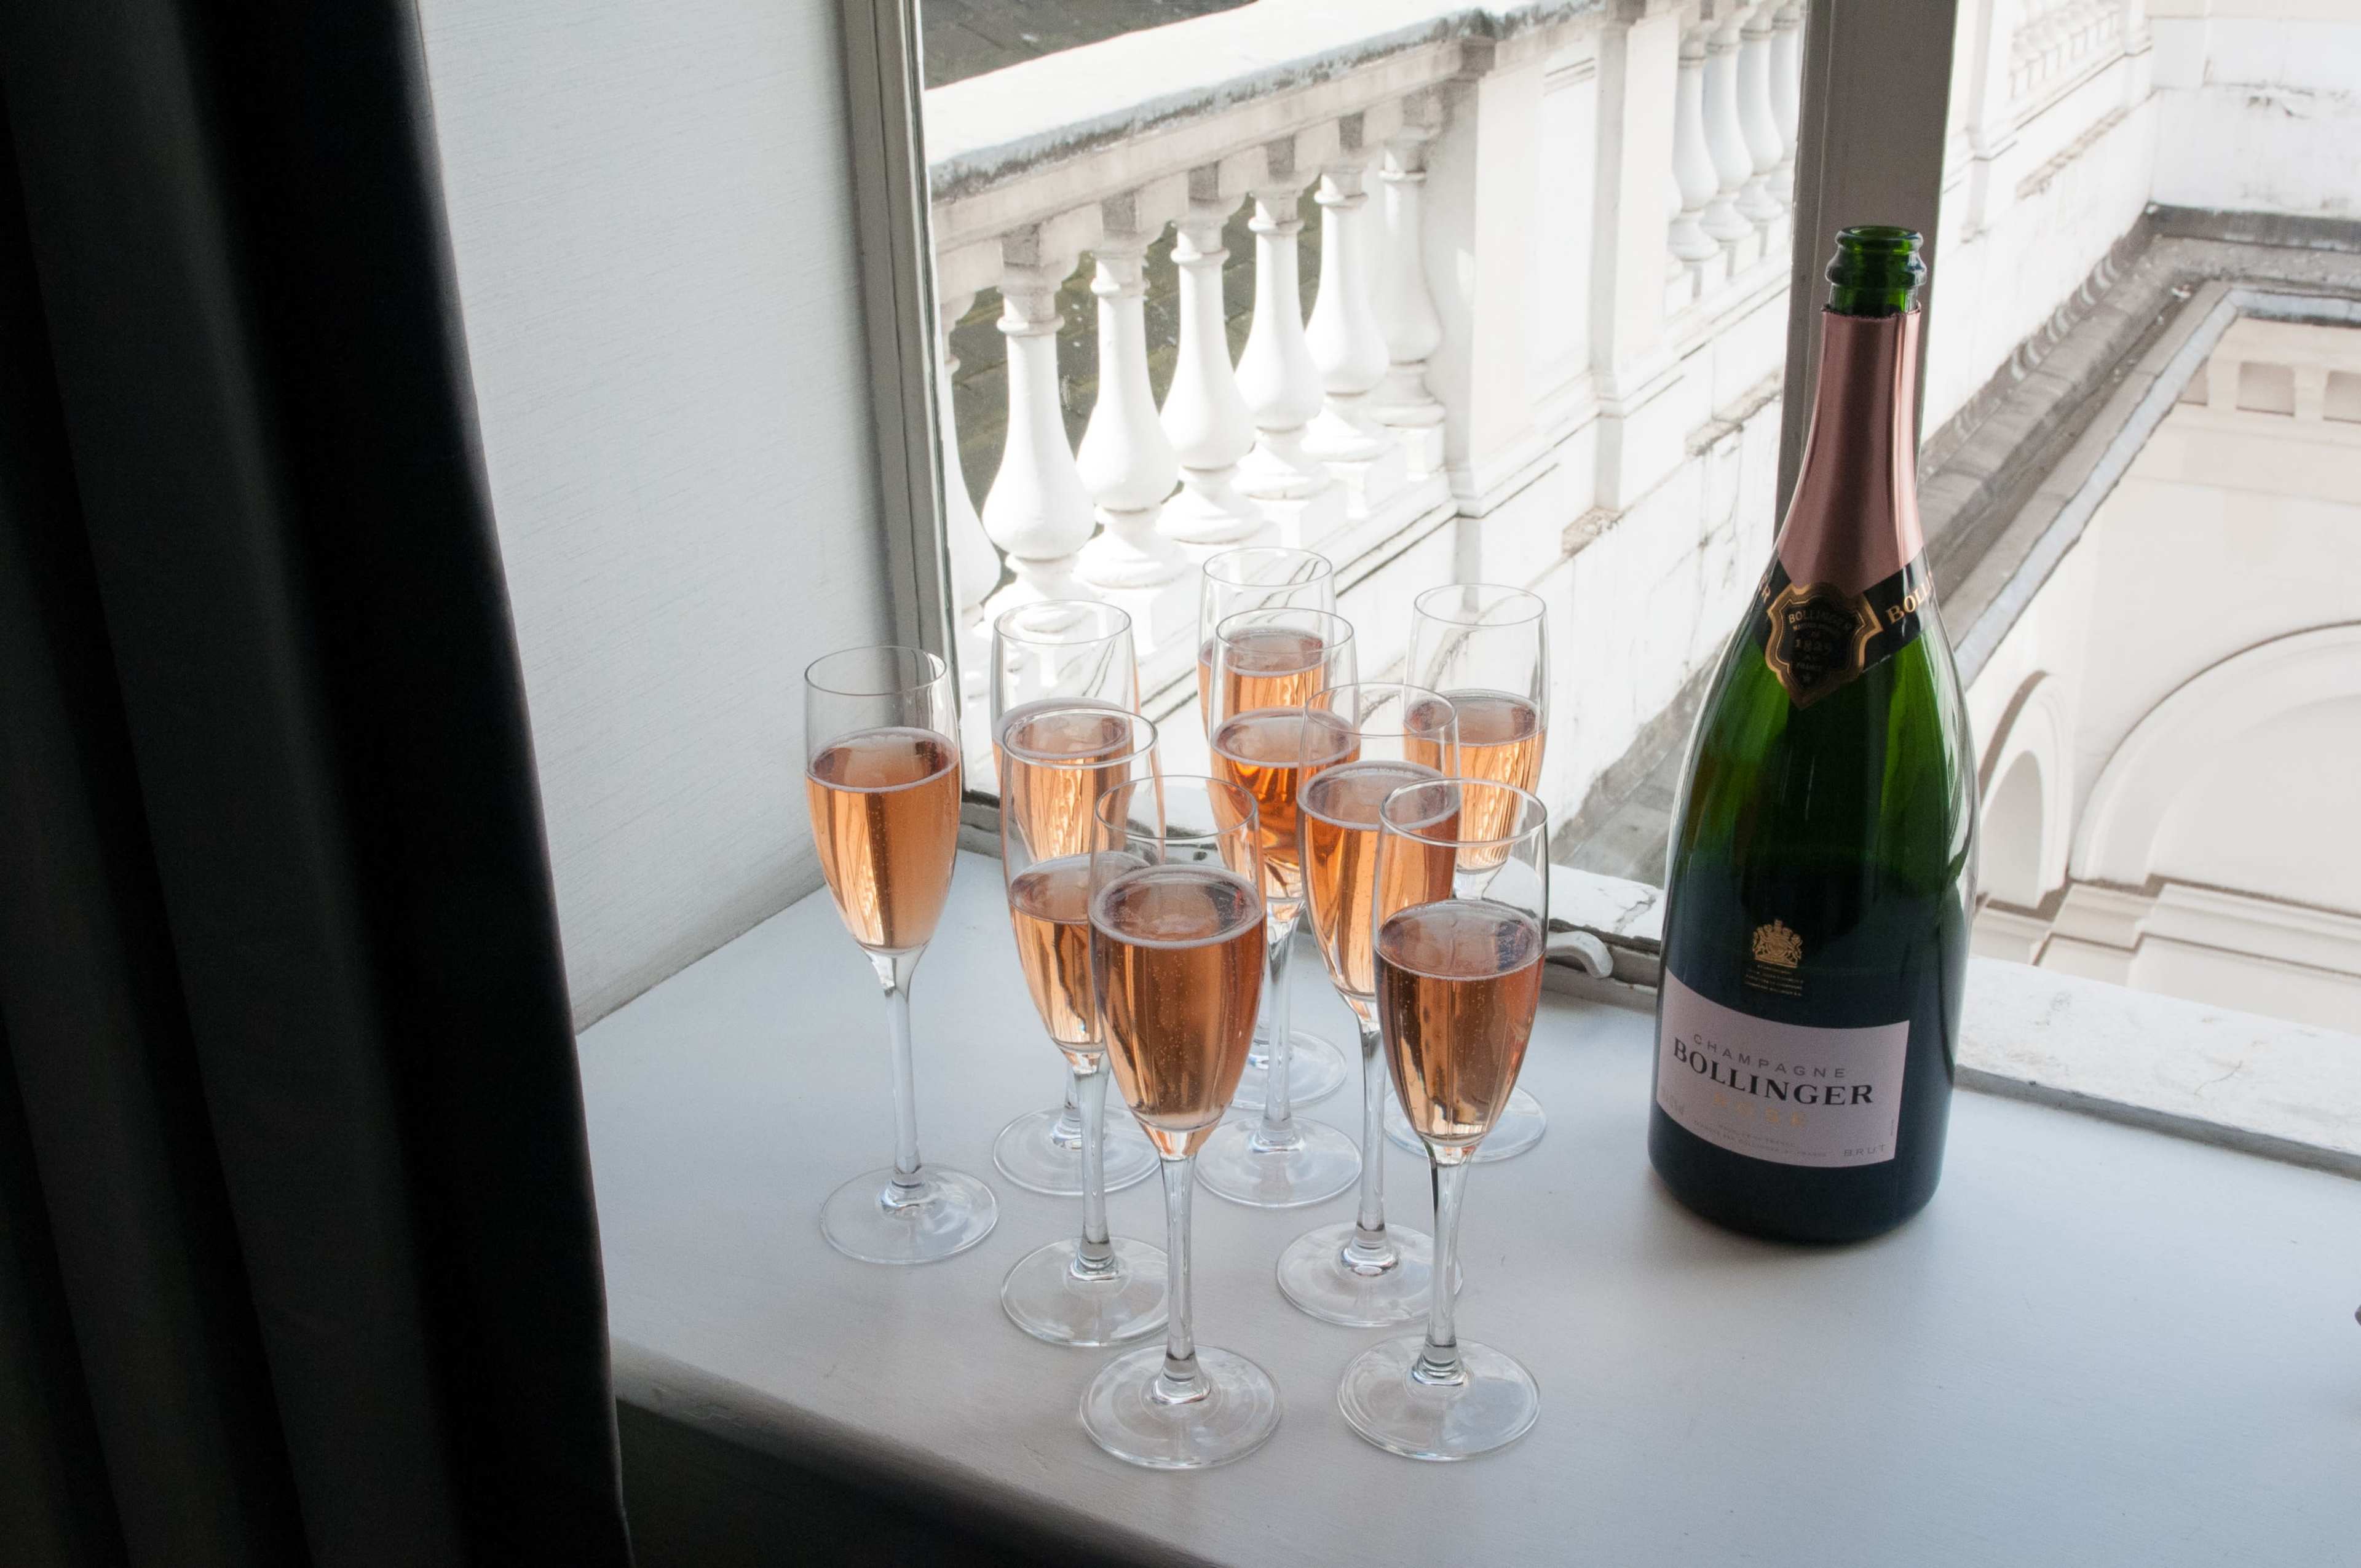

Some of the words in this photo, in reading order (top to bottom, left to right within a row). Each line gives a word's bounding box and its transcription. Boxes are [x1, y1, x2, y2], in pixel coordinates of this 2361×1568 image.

[1674, 1037, 1874, 1106] BOLLINGER
[1694, 1034, 1846, 1077] CHAMPAGNE
[1843, 1143, 1886, 1157] BRUT
